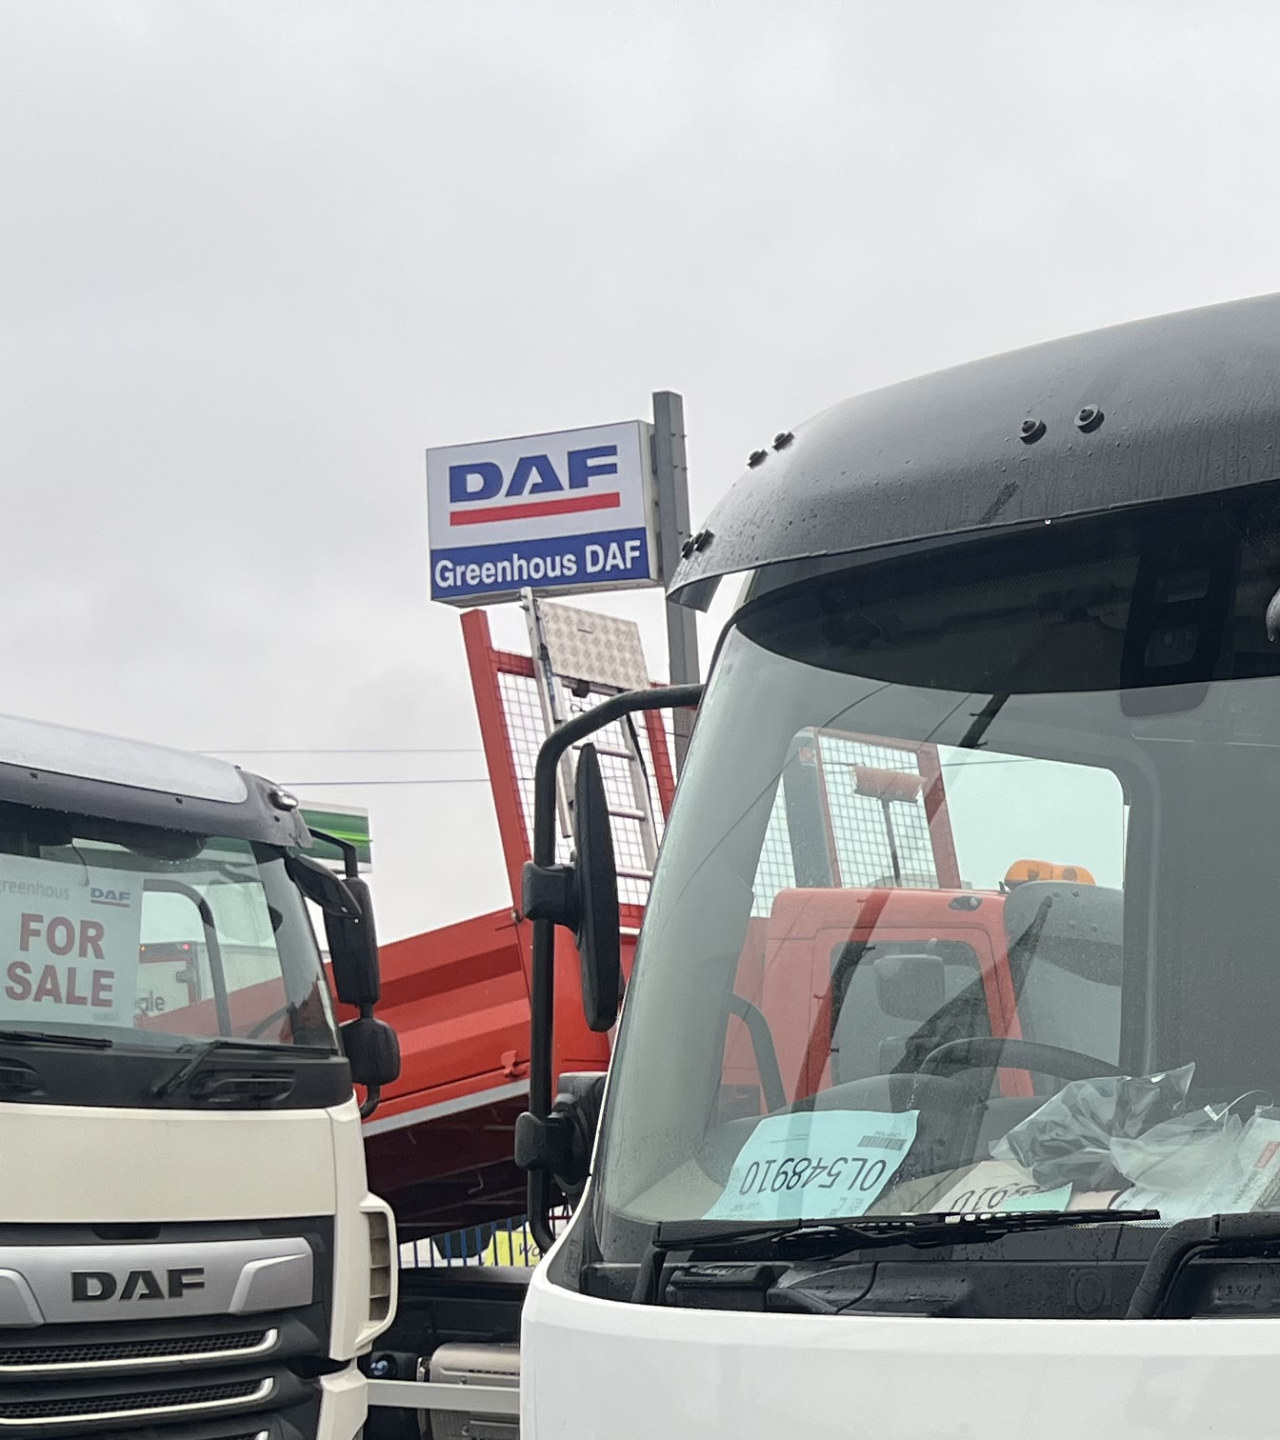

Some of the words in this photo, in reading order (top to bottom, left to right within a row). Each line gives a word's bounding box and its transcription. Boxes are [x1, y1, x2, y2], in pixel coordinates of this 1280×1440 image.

[449, 444, 618, 504] DAF
[434, 553, 577, 588] Greenhous
[584, 540, 641, 574] DAF
[0, 879, 70, 901] reenhous
[90, 887, 131, 901] DAF
[19, 912, 105, 960] FOR
[5, 961, 115, 1008] SALE
[71, 1267, 205, 1302] DAF
